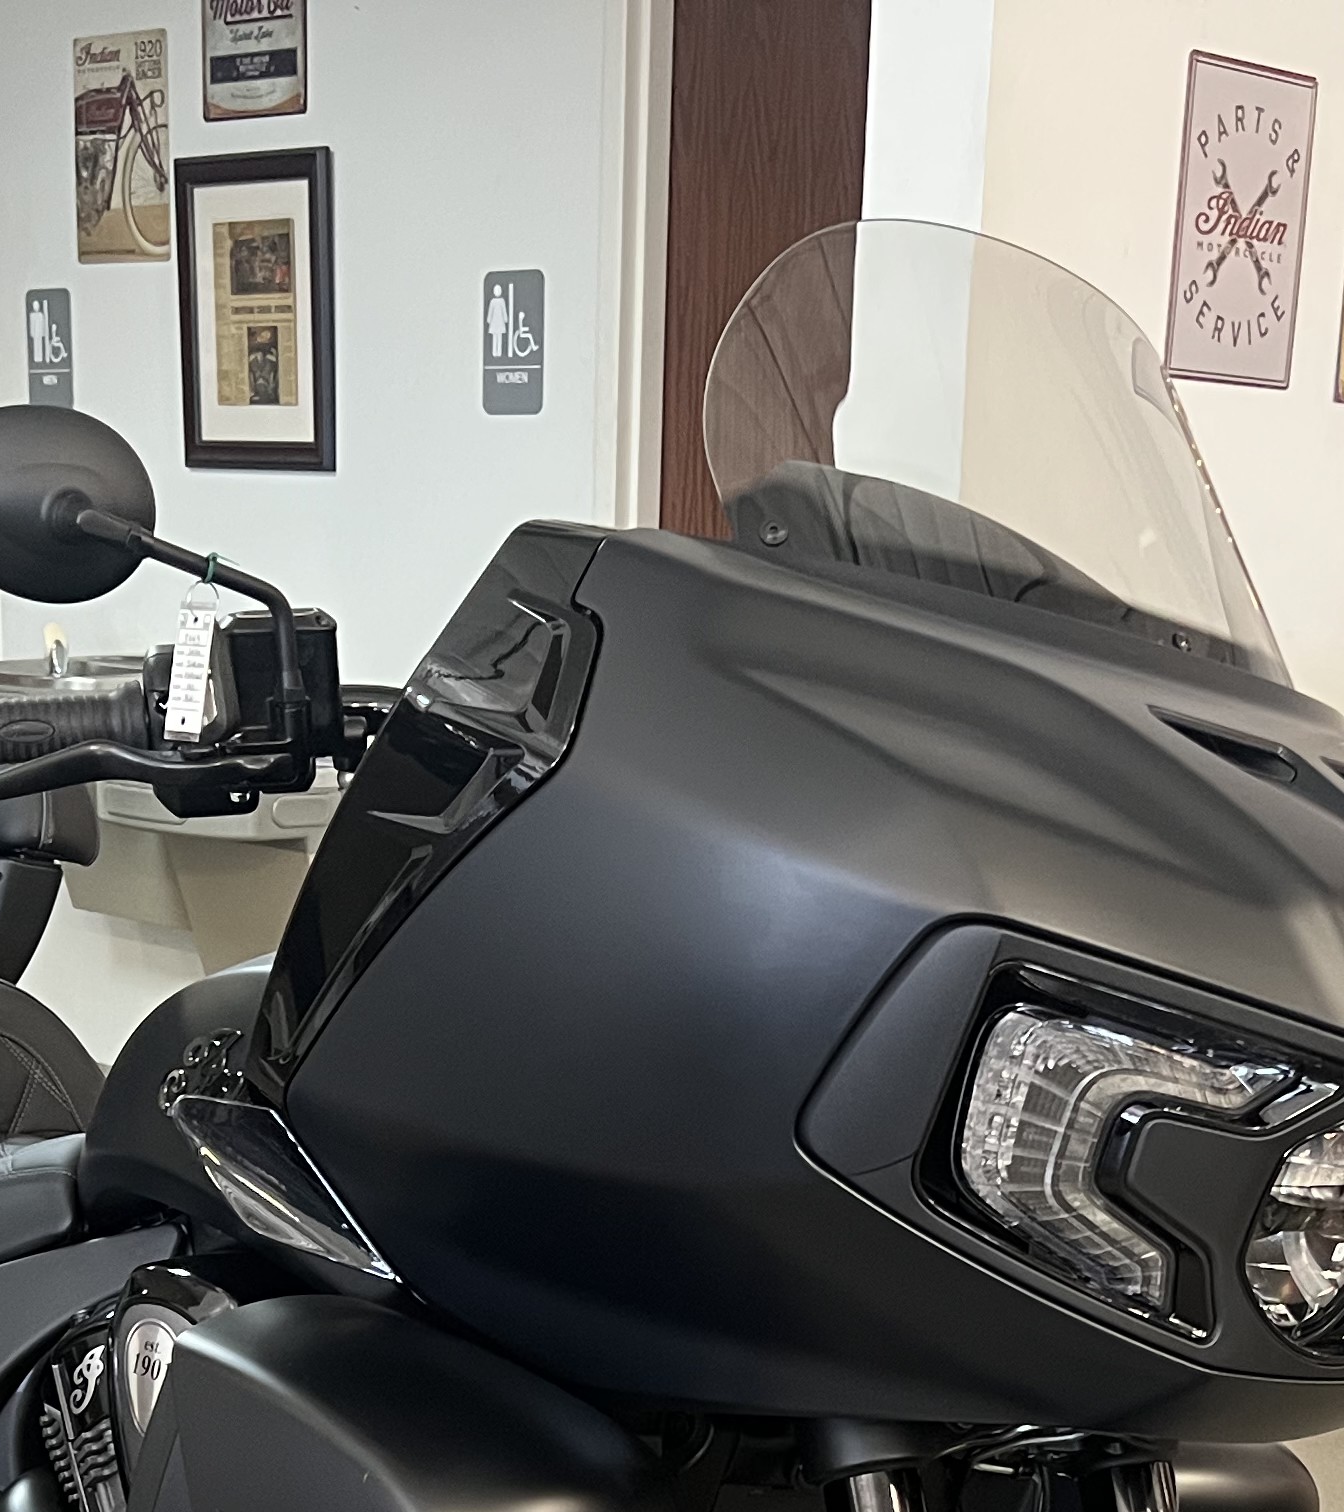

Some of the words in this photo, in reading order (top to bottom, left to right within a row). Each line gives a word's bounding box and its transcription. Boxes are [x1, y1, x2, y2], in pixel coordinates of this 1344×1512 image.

[135, 39, 163, 59] 1920
[1197, 104, 1282, 158] PARTS
[1285, 148, 1301, 178] &
[1195, 190, 1289, 246] Indian
[1183, 279, 1286, 348] SERVICE
[496, 371, 528, 384] WOMEN
[132, 1352, 162, 1381] 190
